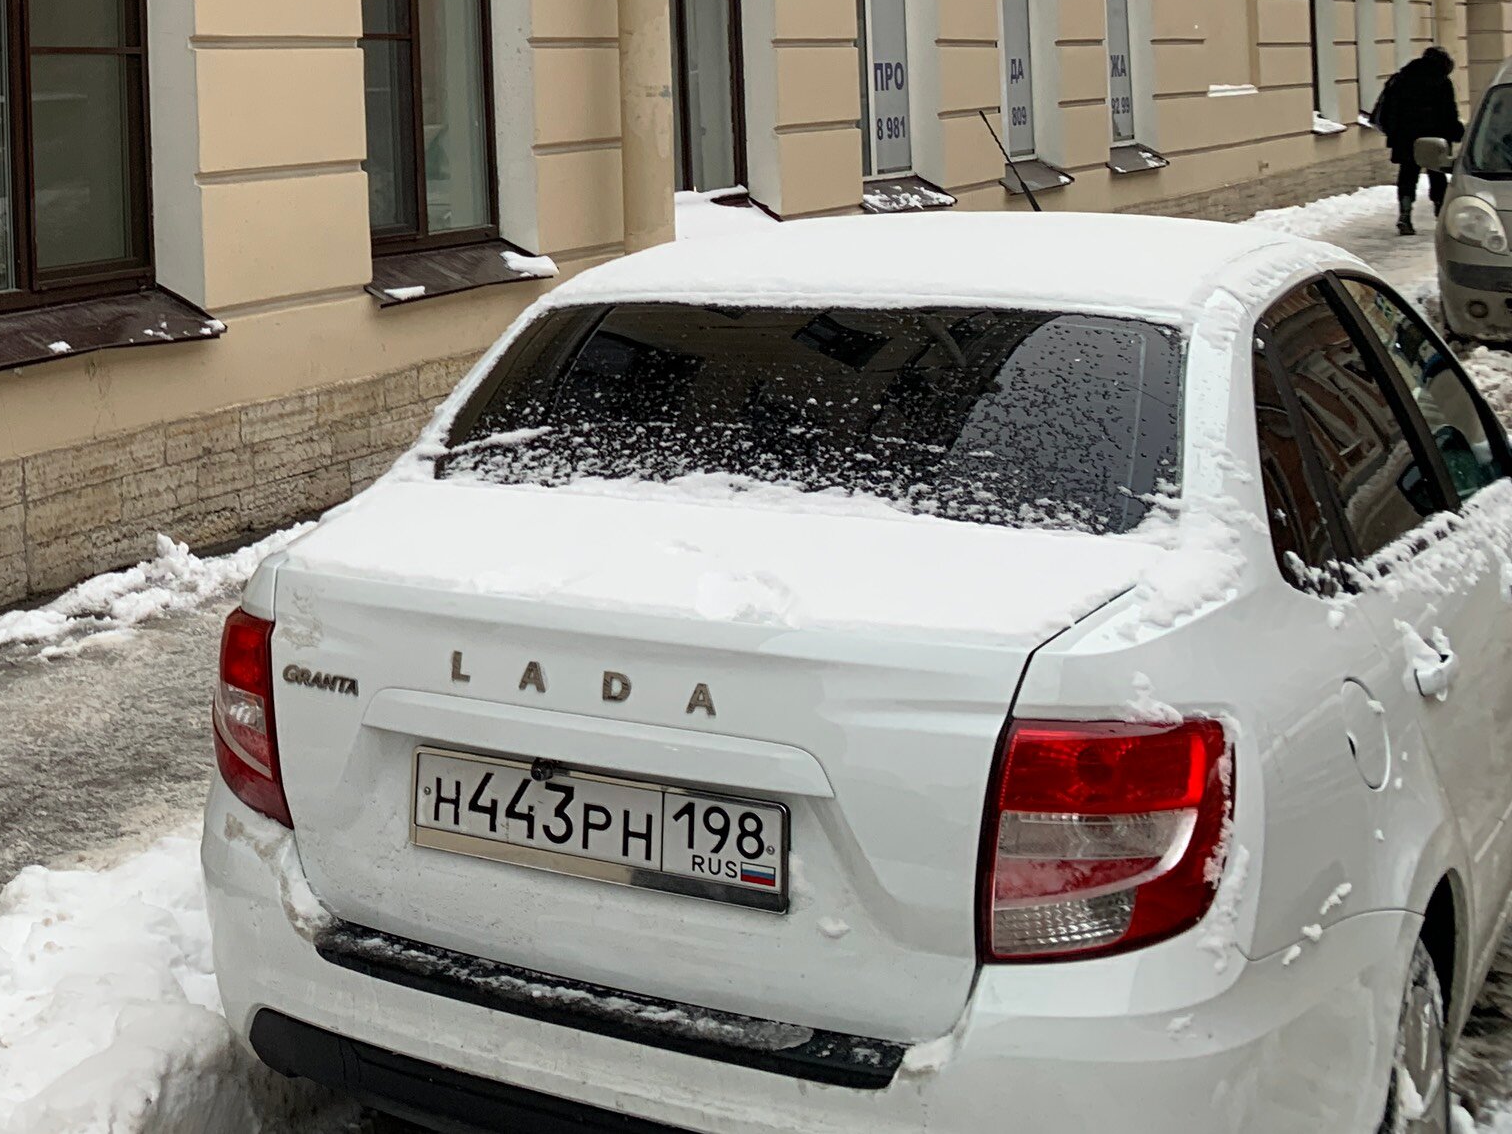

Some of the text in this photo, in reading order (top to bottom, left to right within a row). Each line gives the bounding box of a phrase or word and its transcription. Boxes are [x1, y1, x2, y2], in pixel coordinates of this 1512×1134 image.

[873, 54, 1128, 91] ПРО ДА ЖА
[876, 118, 884, 141] 8
[886, 116, 906, 139] 981
[282, 663, 359, 696] GRANTA
[450, 650, 717, 717] LADA
[672, 801, 767, 860] 198
[691, 854, 738, 879] RUS
